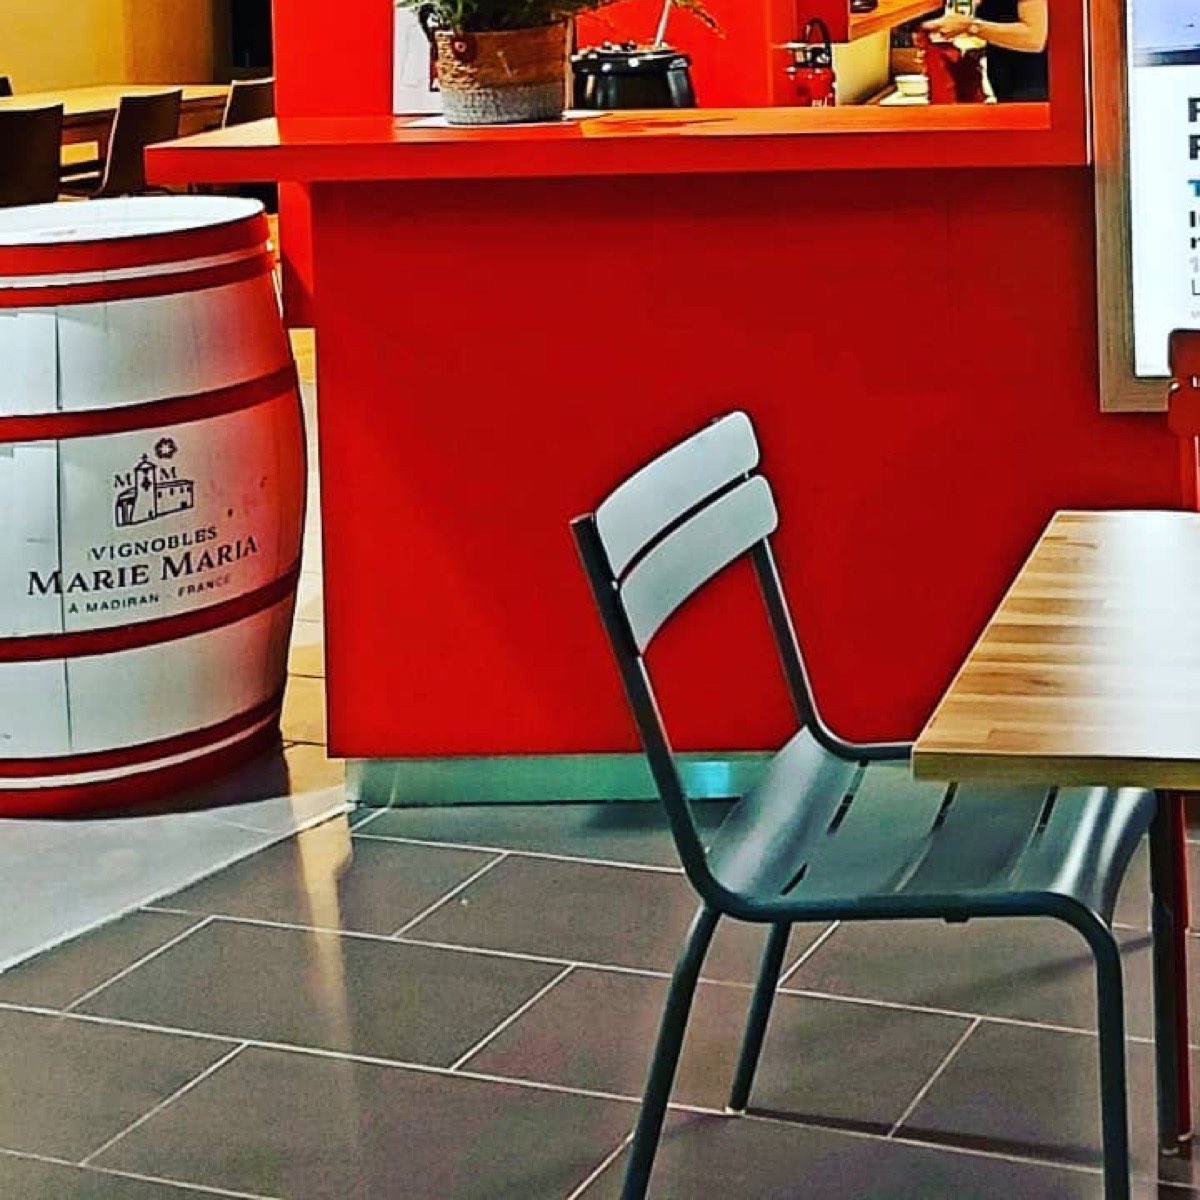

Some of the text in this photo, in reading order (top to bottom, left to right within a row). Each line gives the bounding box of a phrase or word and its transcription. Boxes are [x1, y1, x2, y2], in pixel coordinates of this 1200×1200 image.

[90, 526, 218, 561] VIGNOBLES
[27, 536, 258, 596] MARIE MARIA
[86, 593, 160, 613] MADIRAN
[177, 573, 231, 598] FRANCE
